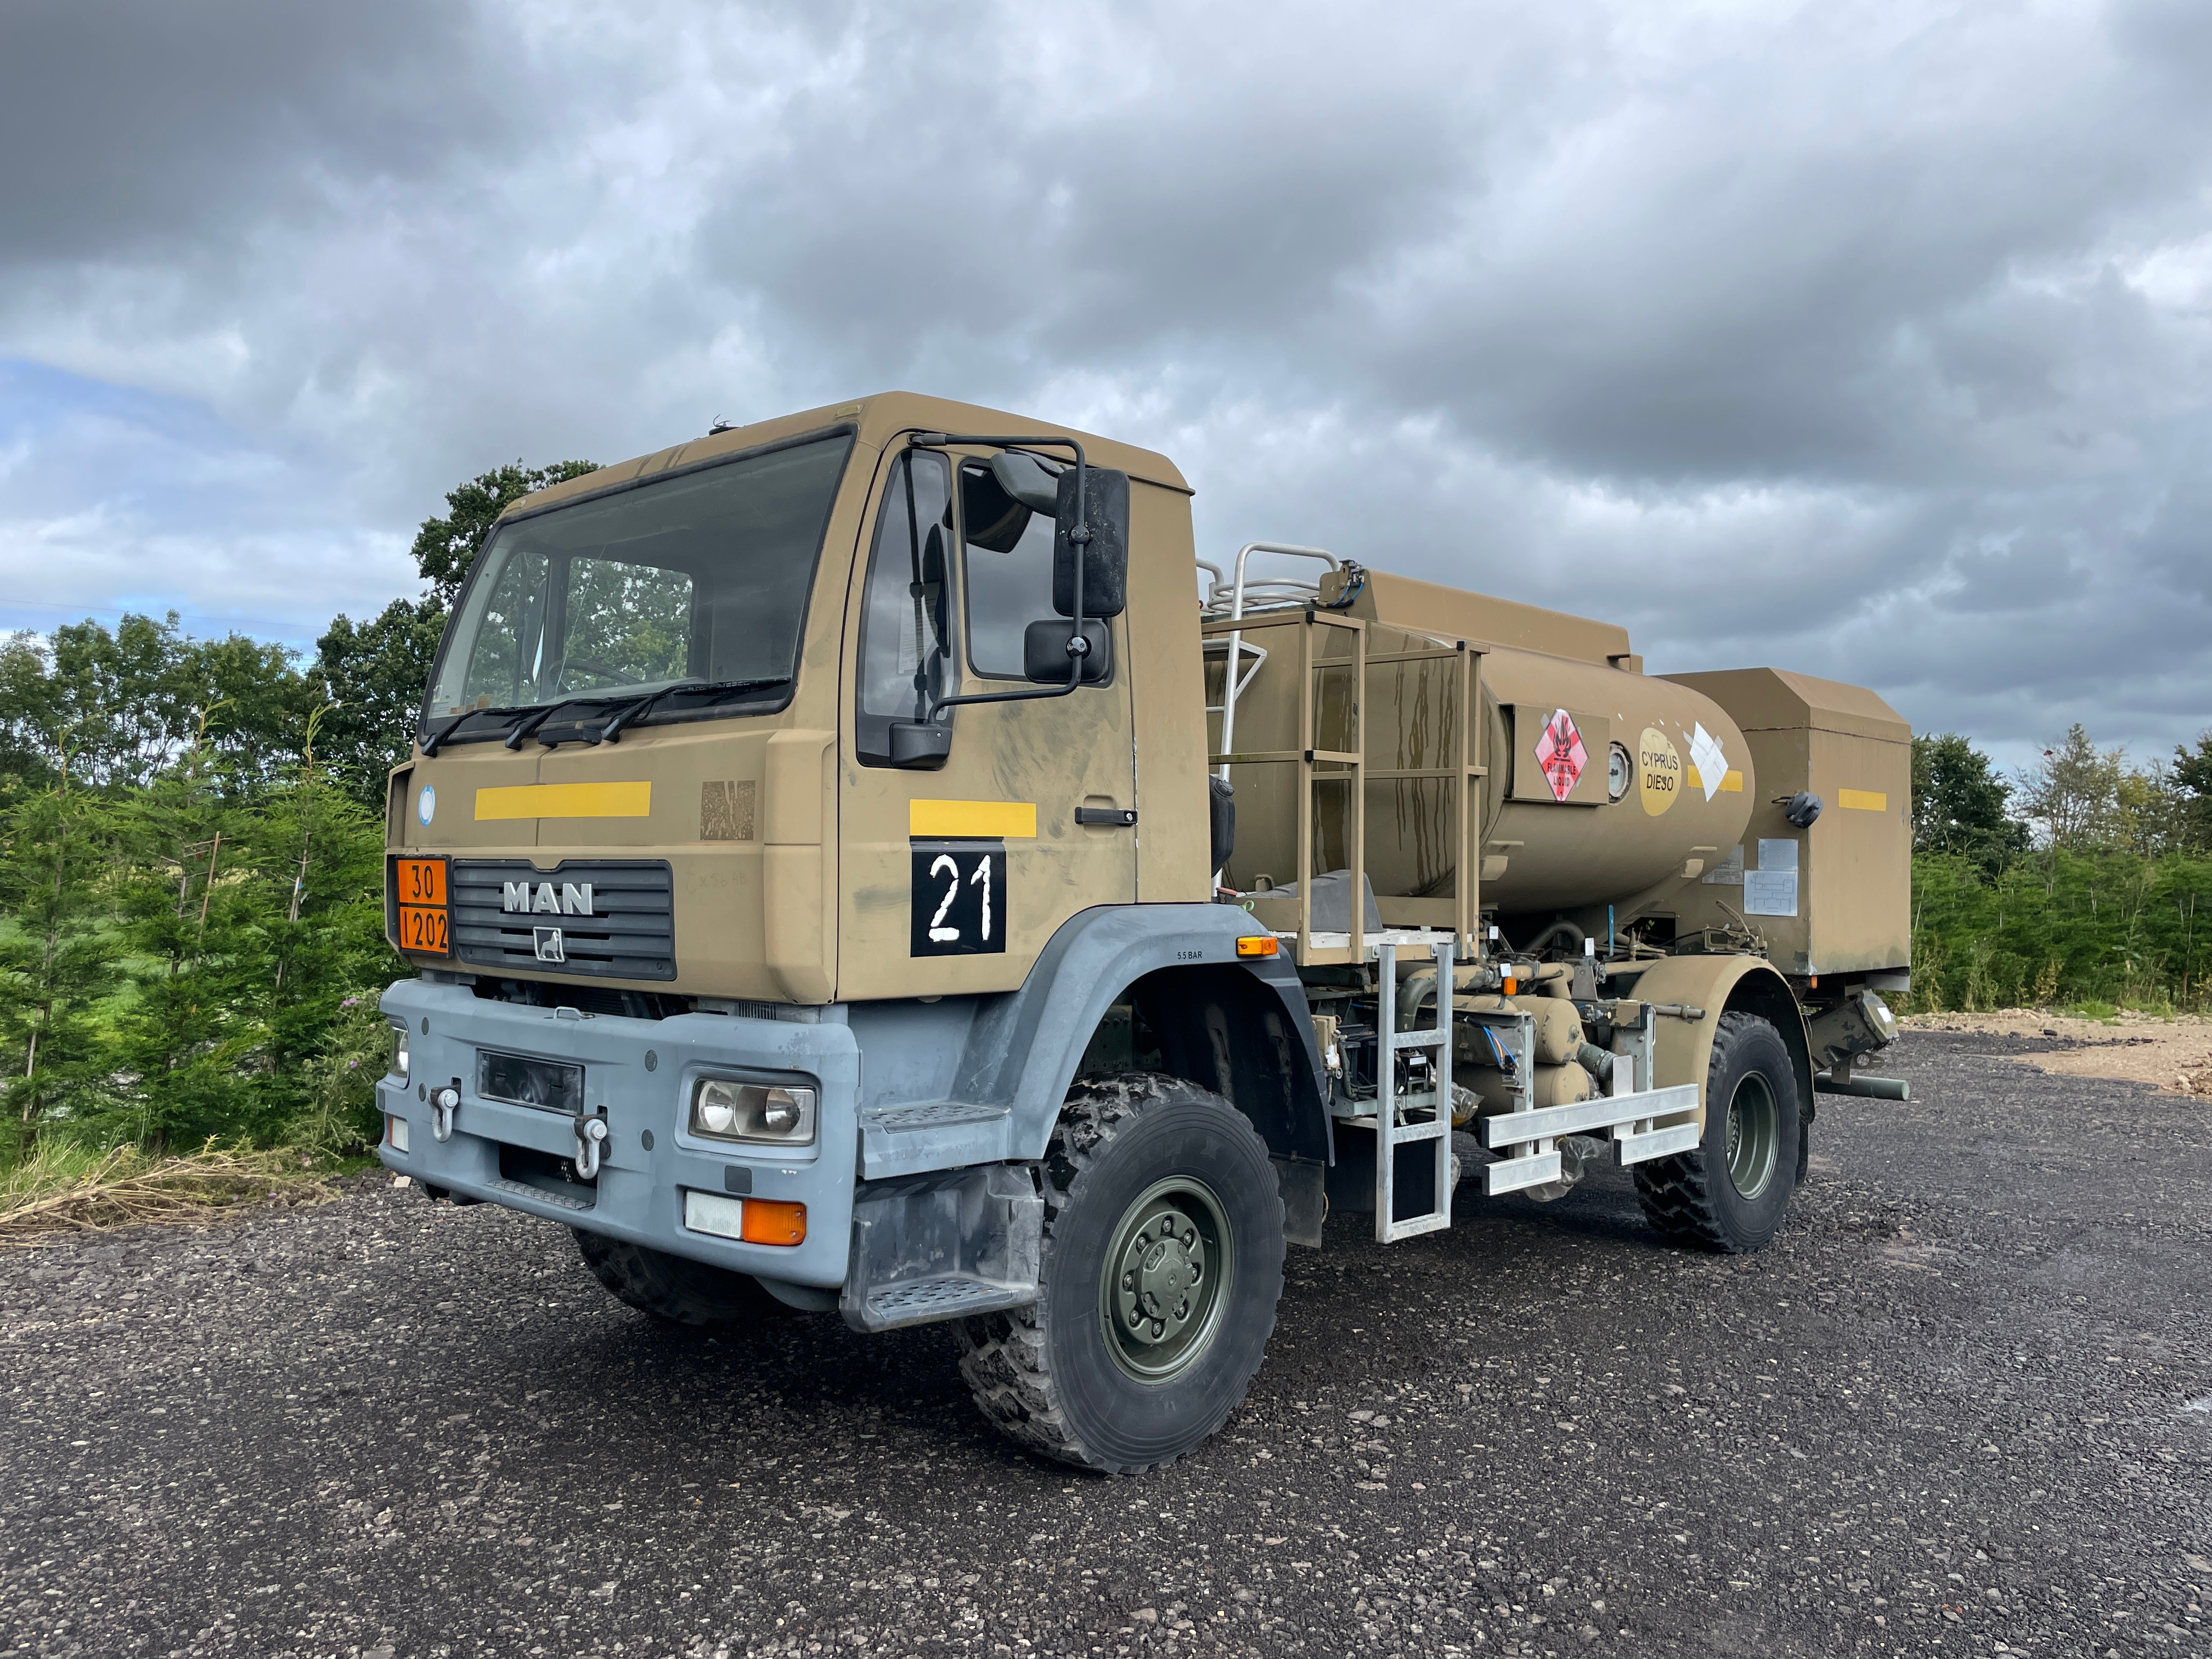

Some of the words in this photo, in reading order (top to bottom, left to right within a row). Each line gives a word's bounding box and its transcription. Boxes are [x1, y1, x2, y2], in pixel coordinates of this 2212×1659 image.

[1547, 762, 1576, 775] FLAMMABLE
[1641, 751, 1678, 771] CYPRUS
[1553, 775, 1570, 787] LIQUID
[411, 865, 433, 899] 30
[504, 882, 593, 915] MAN
[928, 854, 991, 943] 21
[404, 911, 447, 949] 1202
[1188, 951, 1203, 960] BAR
